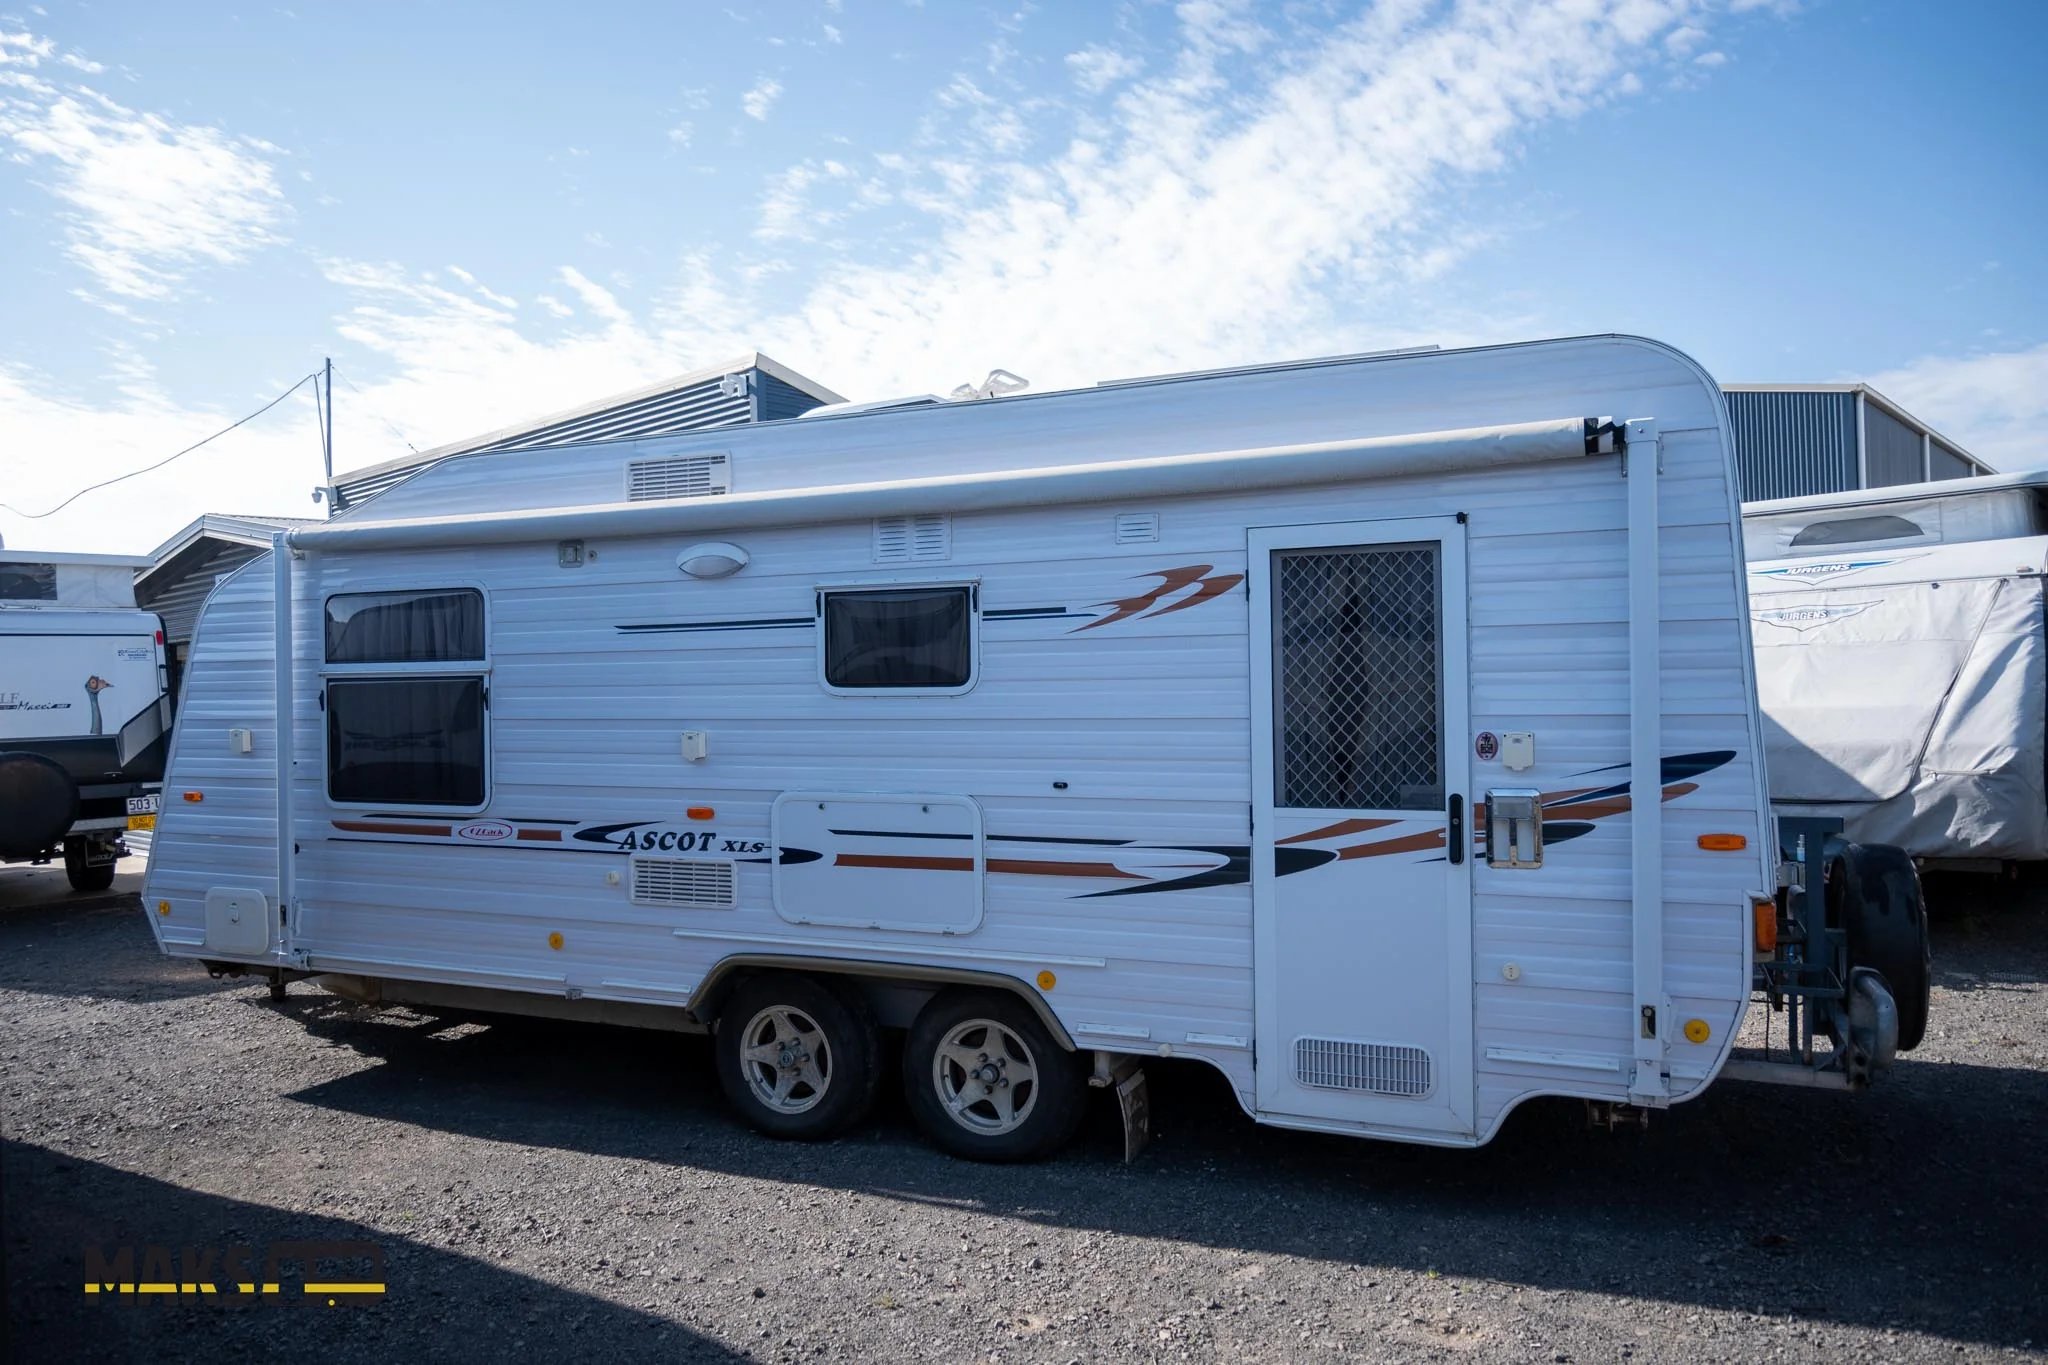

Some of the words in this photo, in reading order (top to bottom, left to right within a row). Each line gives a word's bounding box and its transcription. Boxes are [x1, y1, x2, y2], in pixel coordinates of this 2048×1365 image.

[1785, 563, 1851, 575] JURGENS
[1779, 610, 1828, 621] JURGENS
[617, 830, 717, 851] ASCOT
[721, 840, 765, 853] XLS
